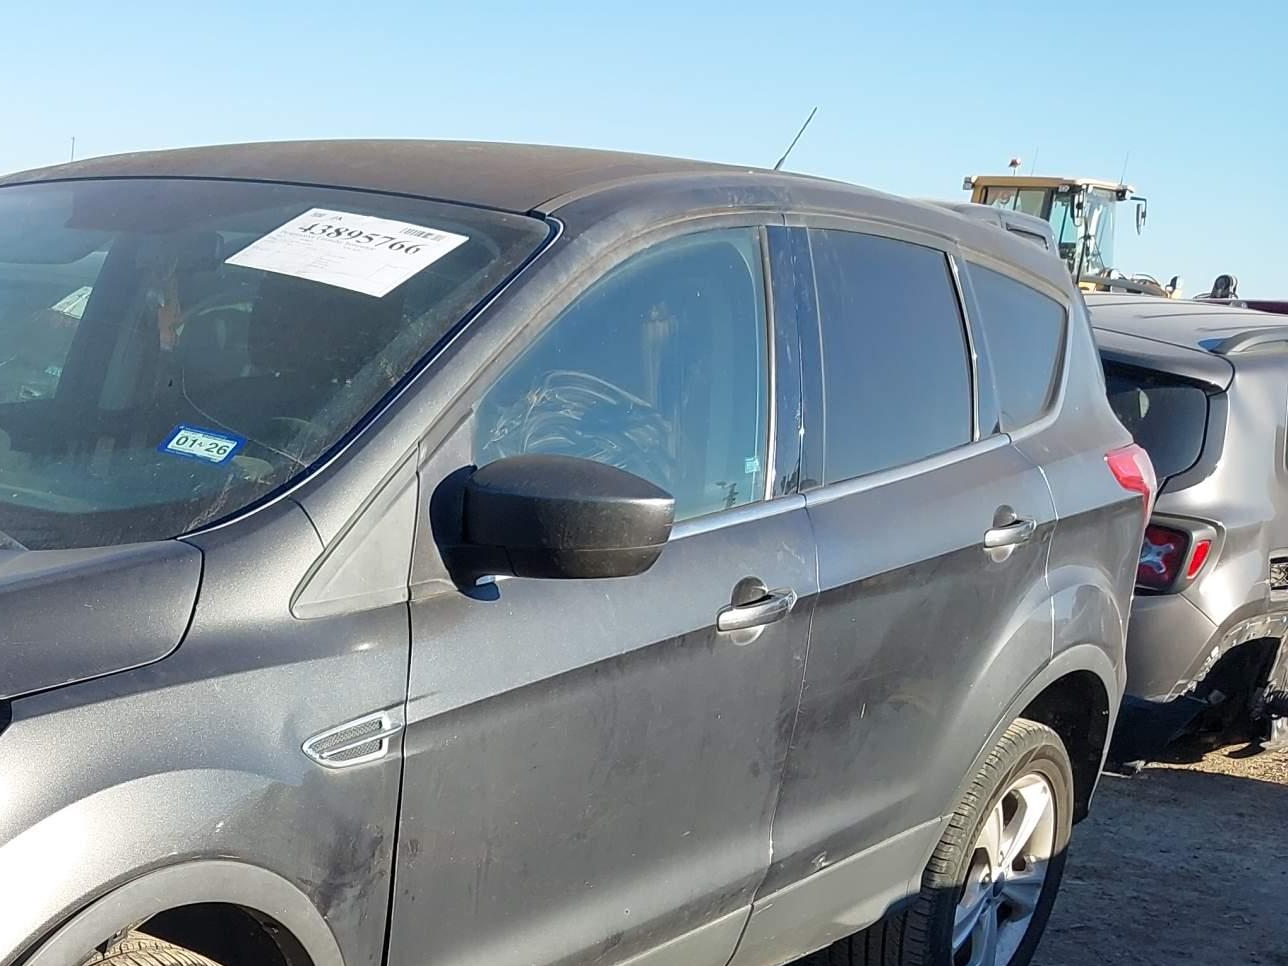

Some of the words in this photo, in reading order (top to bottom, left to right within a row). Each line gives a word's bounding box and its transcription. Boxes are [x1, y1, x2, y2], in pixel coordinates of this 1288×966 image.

[298, 222, 421, 255] 43895766
[176, 436, 198, 448] 01
[205, 443, 229, 455] 26
